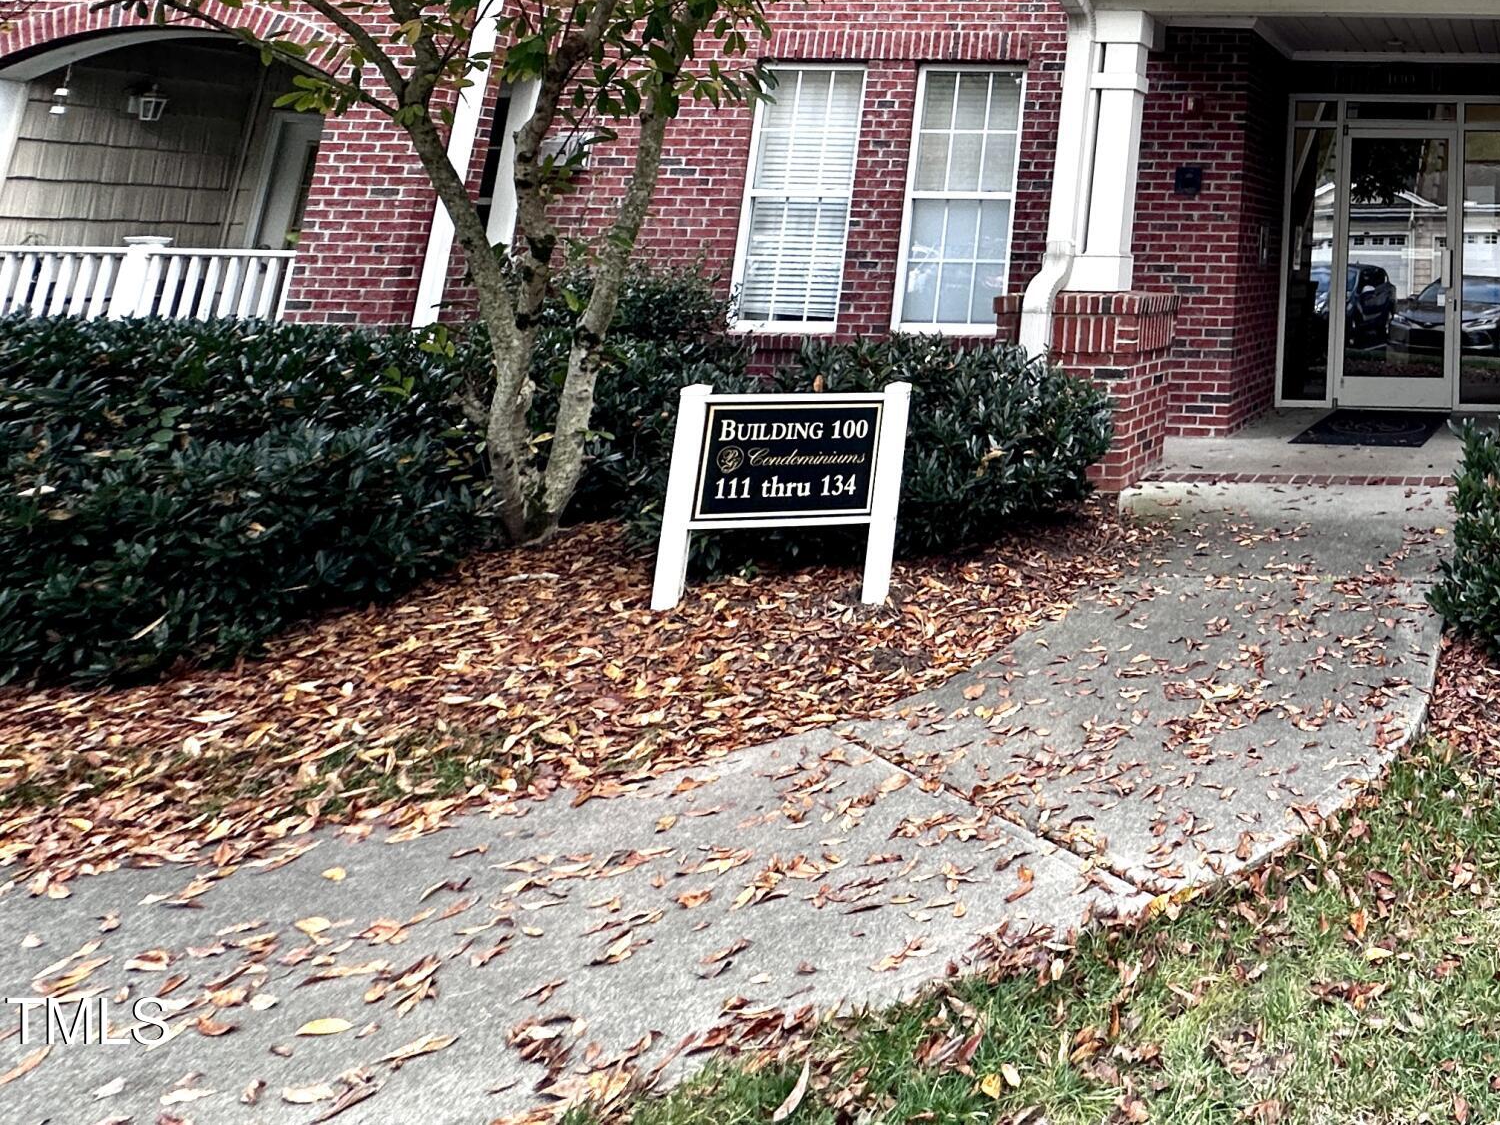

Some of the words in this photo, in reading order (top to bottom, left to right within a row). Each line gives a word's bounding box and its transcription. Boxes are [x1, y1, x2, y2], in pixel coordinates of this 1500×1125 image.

[719, 420, 824, 442] BUILDING
[831, 420, 869, 439] 100
[748, 447, 866, 467] Condominiums
[715, 477, 751, 499] 111
[762, 475, 811, 498] thru
[821, 474, 857, 497] 134
